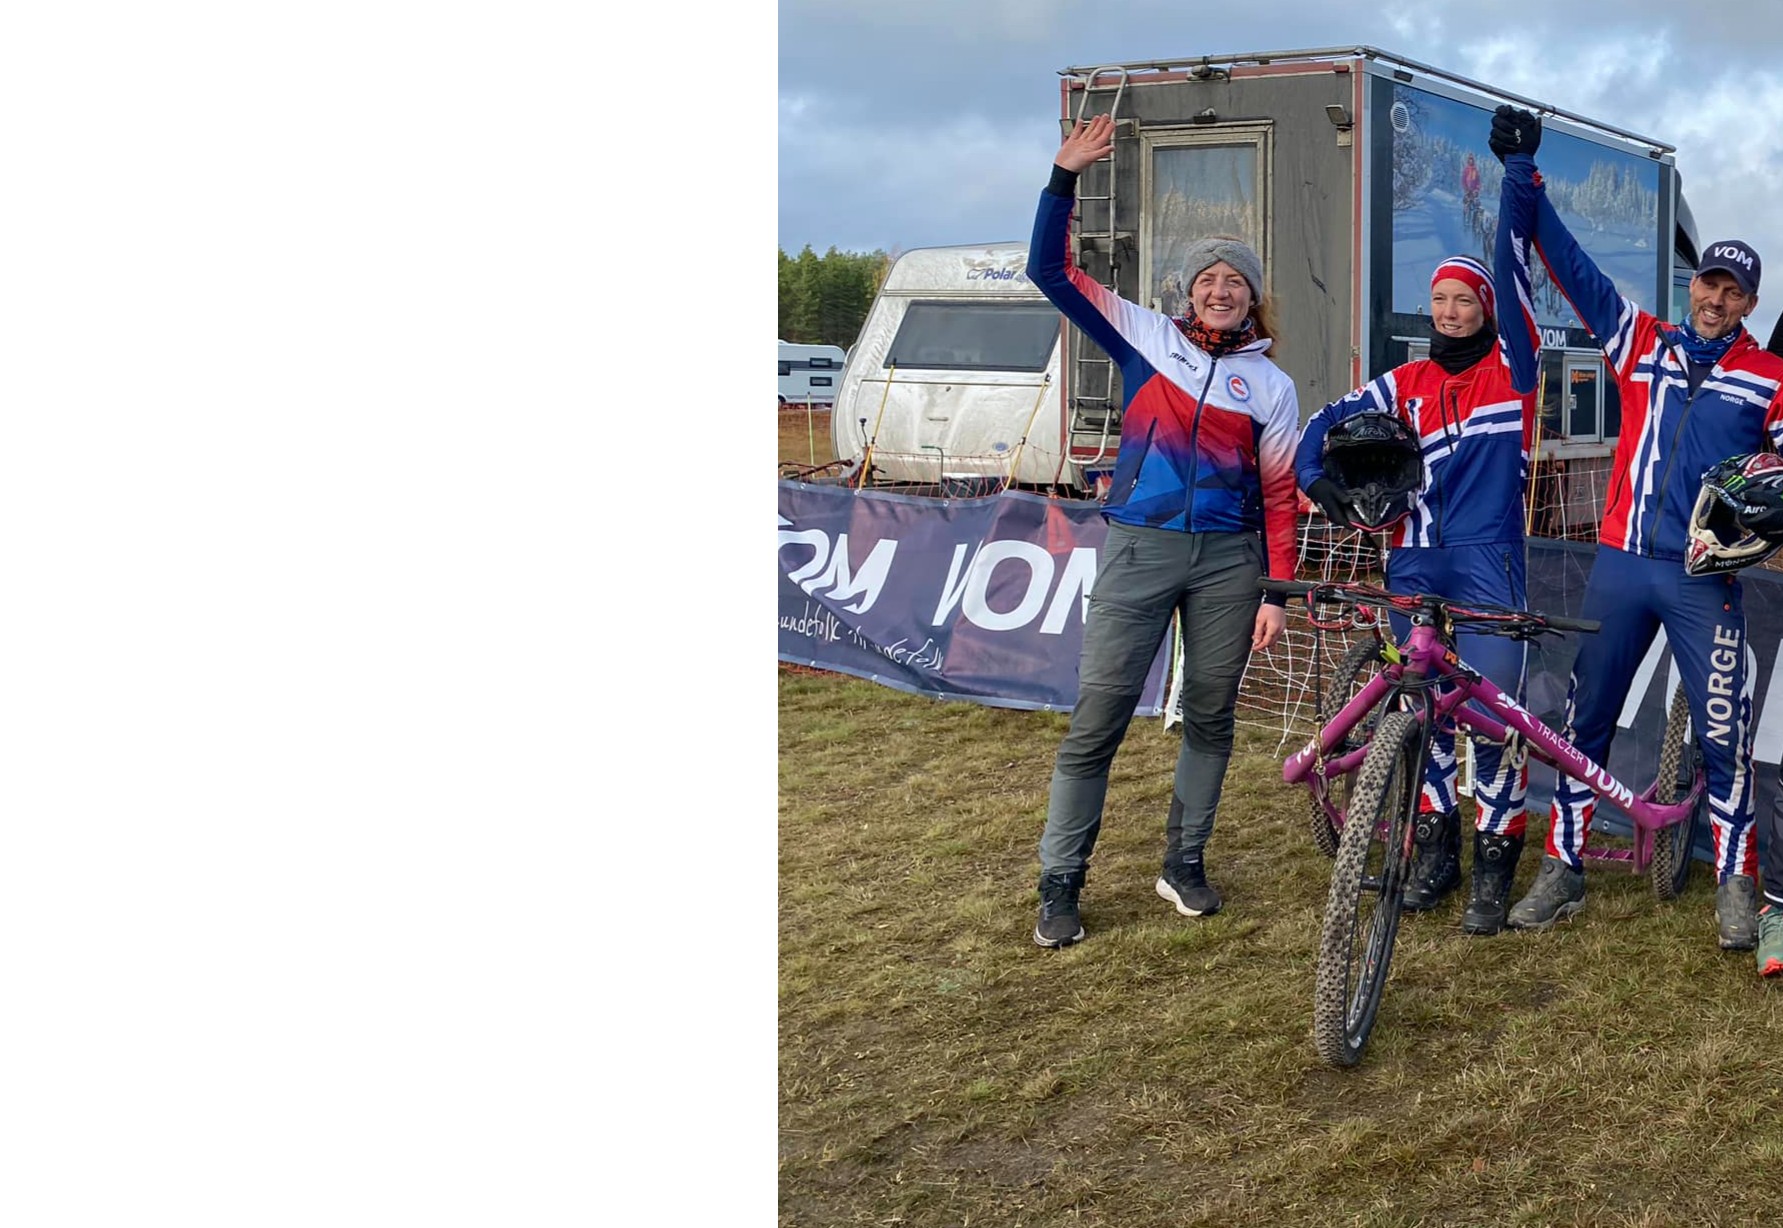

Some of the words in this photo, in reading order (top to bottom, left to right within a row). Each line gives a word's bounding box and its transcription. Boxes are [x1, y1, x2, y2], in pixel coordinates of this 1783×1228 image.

[1714, 246, 1753, 271] VOM
[984, 267, 1017, 280] Polar
[1720, 394, 1744, 406] NORGE
[1706, 624, 1740, 746] NORGE
[1538, 721, 1584, 764] TRACZER
